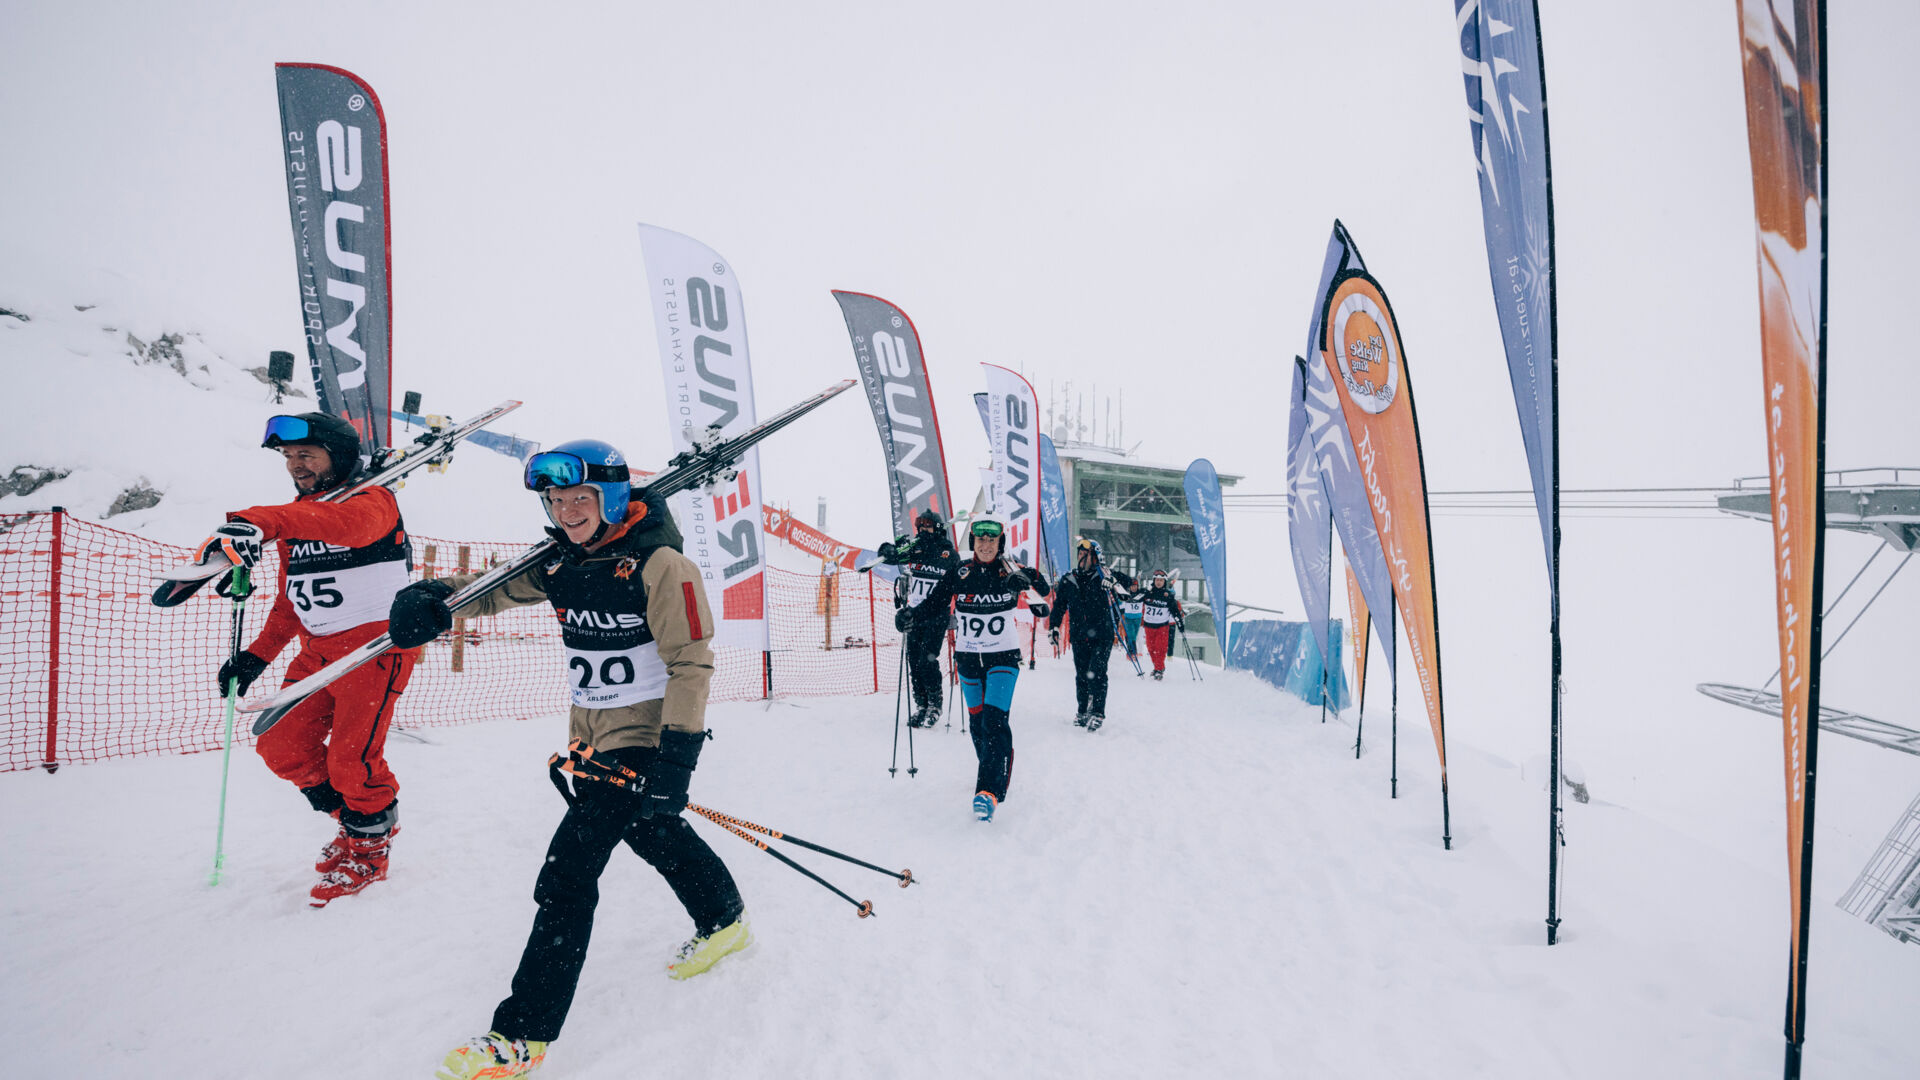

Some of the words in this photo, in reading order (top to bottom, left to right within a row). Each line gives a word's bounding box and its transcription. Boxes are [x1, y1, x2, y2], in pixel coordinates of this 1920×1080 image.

[791, 526, 834, 559] ROSSIGNOL
[956, 592, 1013, 604] REMUS
[1146, 607, 1163, 616] 214
[578, 628, 598, 637] SPORT
[961, 615, 1006, 638] 190
[570, 655, 635, 689] 20
